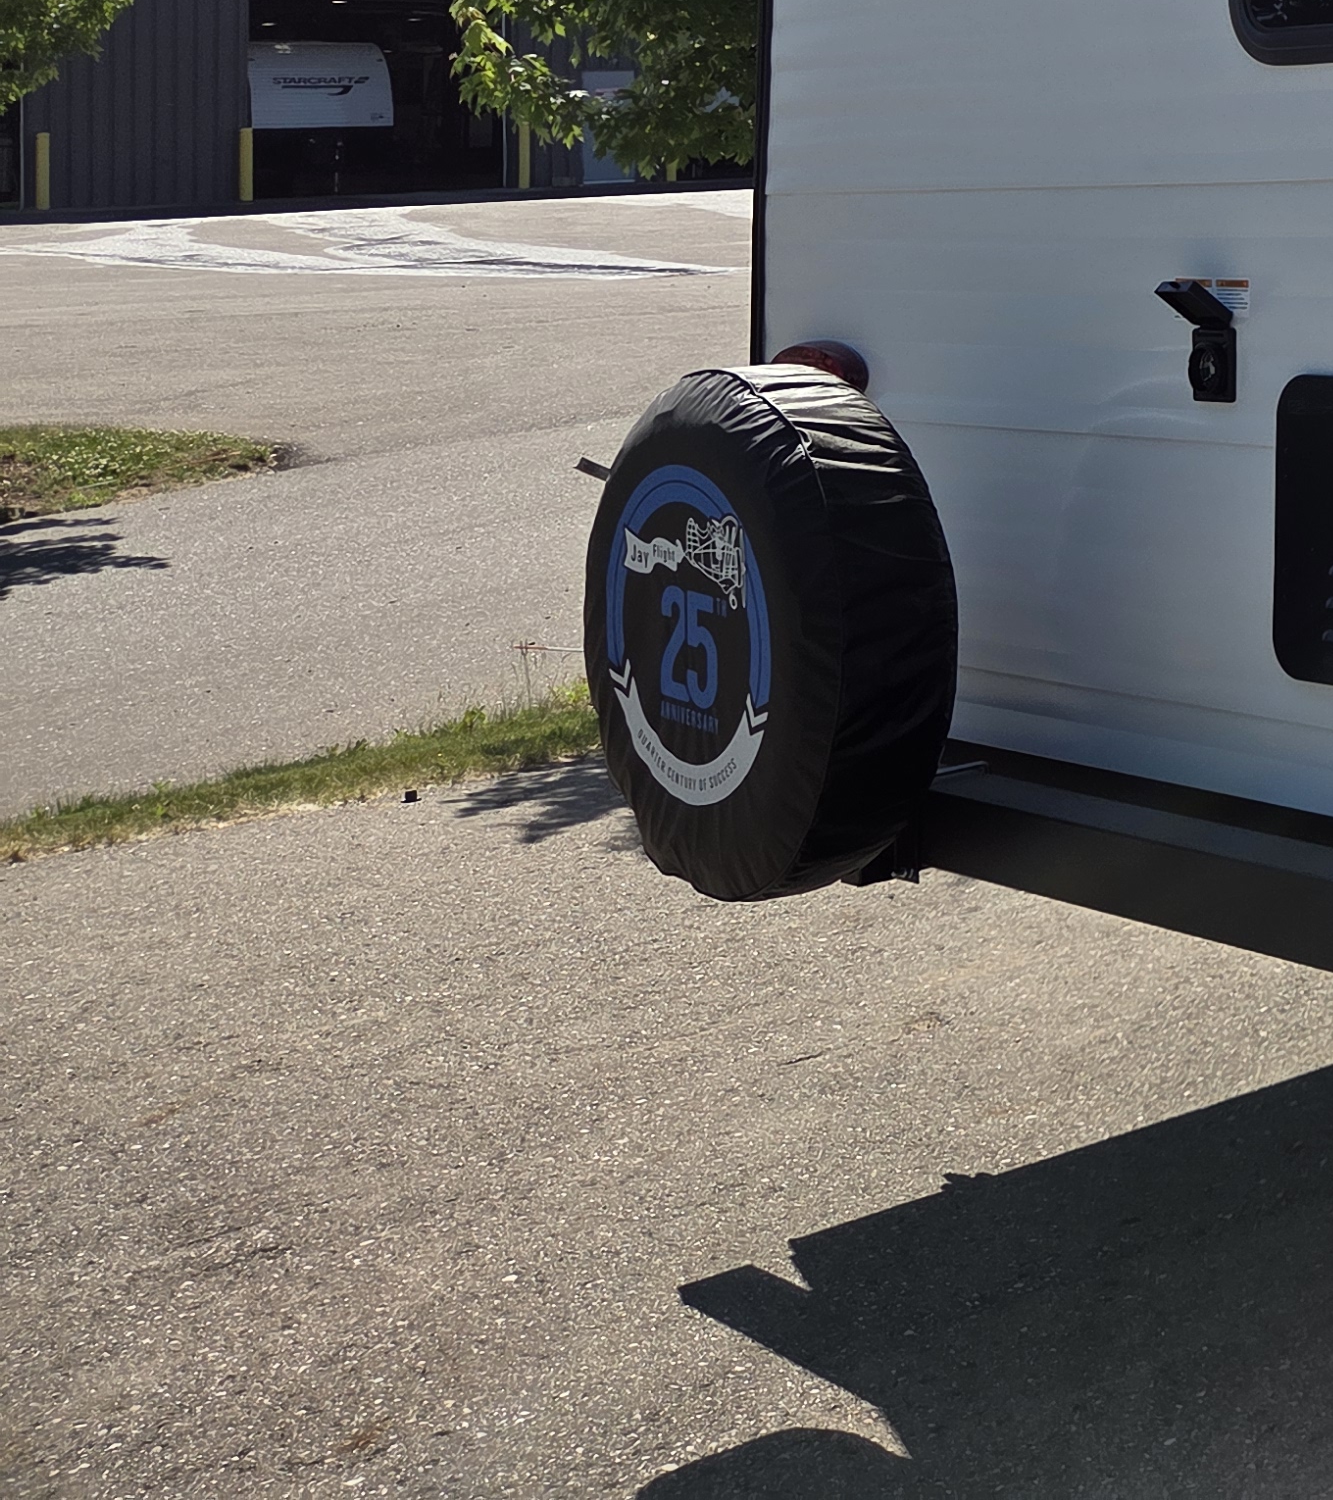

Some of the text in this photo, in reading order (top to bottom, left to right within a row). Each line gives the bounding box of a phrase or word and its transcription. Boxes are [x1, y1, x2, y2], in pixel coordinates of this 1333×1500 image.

[272, 76, 355, 85] STARCRAFT
[631, 543, 676, 569] Jay Flight
[660, 700, 719, 735] ANNIVERSARY
[637, 727, 738, 792] QUARTER CENTURY OF SUCCESS
